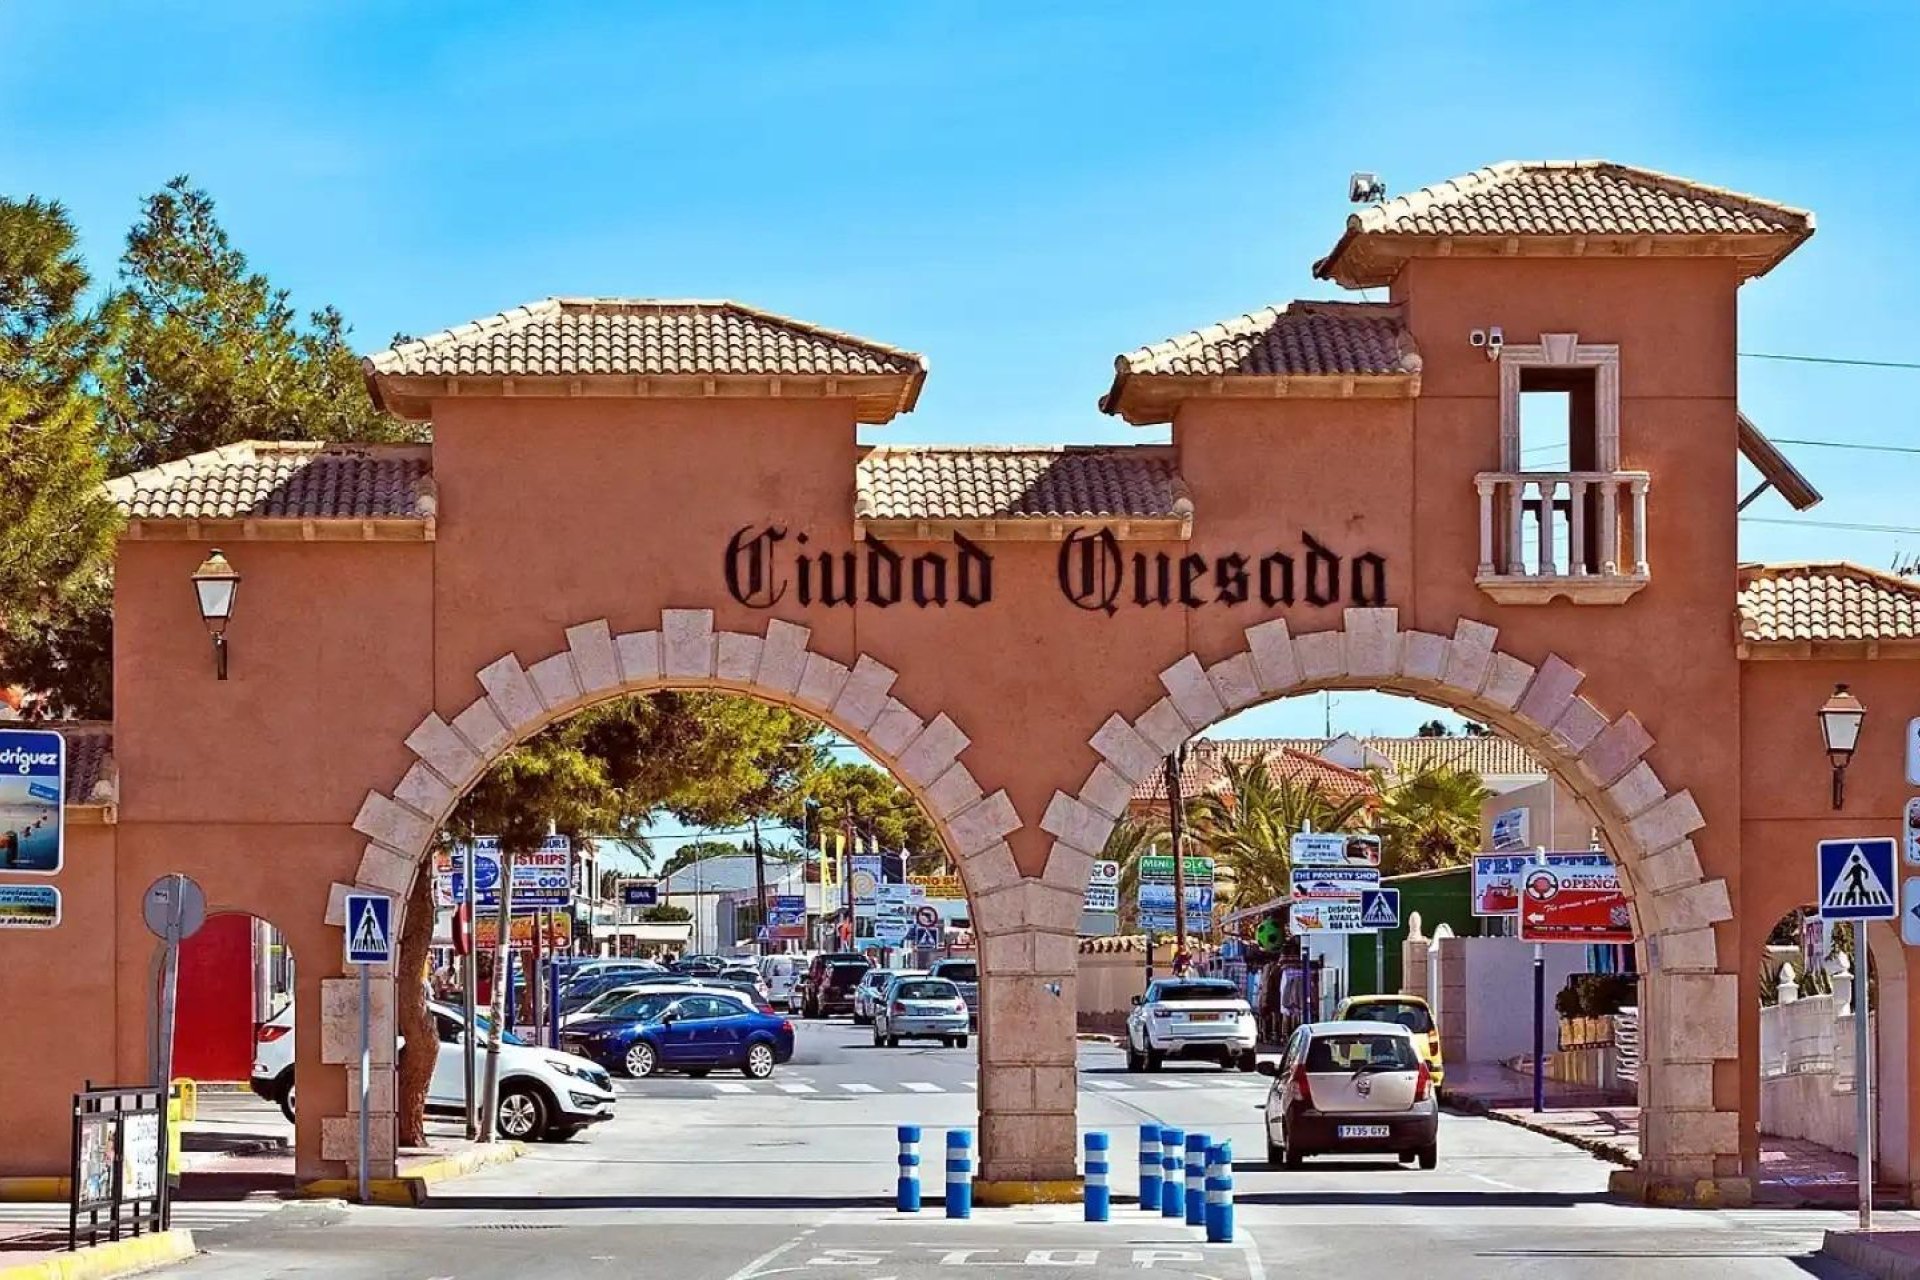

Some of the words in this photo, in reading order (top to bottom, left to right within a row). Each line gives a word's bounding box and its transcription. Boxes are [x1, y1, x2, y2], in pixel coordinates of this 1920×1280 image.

[724, 523, 995, 610] Ciudad
[1057, 524, 1389, 616] Quesada
[1312, 872, 1353, 880] PROPERTY
[1355, 872, 1378, 880] SHOP
[803, 1249, 1204, 1269] STOP
